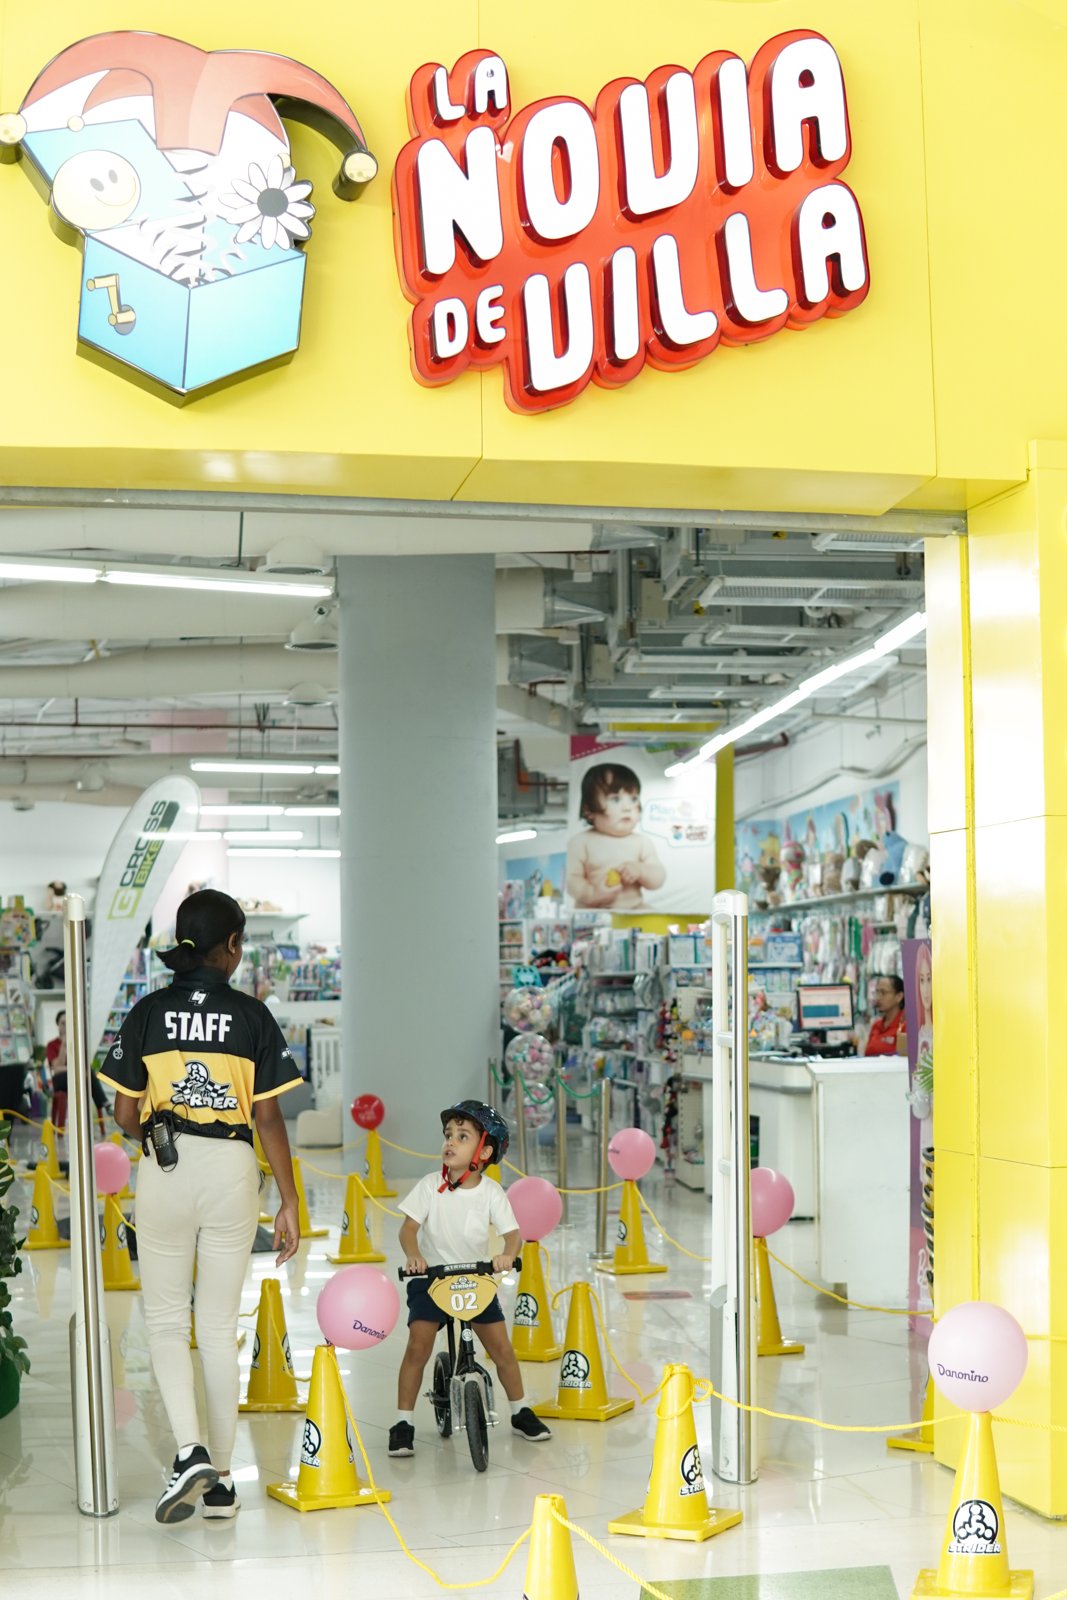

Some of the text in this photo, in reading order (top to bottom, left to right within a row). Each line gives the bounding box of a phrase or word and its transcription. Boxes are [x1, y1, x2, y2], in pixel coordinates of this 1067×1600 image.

[434, 55, 508, 121] LA
[416, 36, 848, 275] NOVIA
[523, 183, 868, 392] VILLA
[432, 284, 507, 359] DE
[164, 1010, 233, 1043] STAFF
[450, 1291, 478, 1312] 02
[936, 1363, 989, 1383] Danonino
[948, 1543, 1001, 1554] STRIDER
